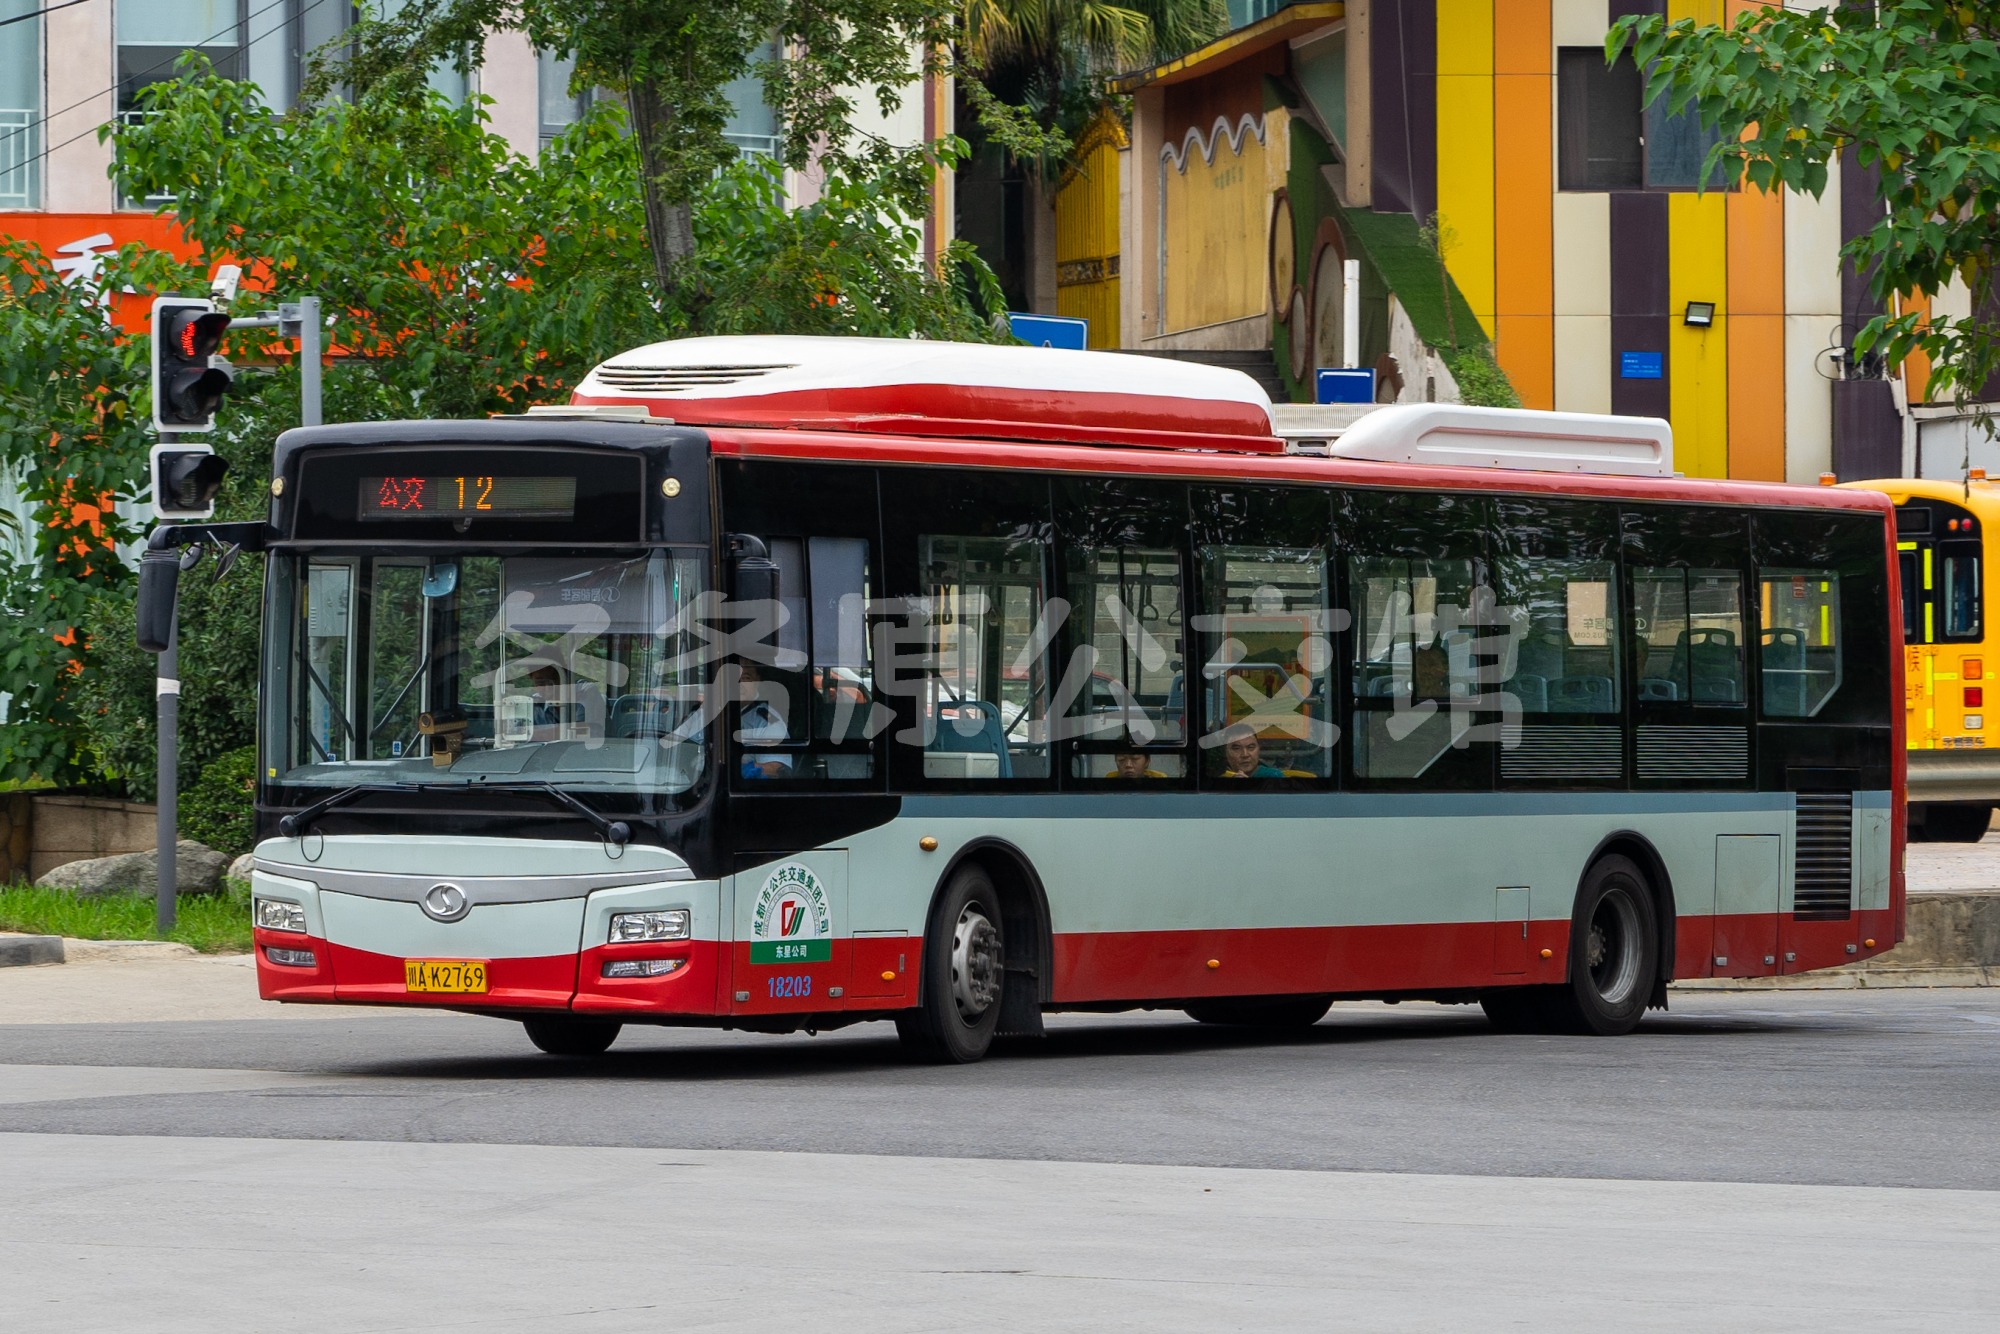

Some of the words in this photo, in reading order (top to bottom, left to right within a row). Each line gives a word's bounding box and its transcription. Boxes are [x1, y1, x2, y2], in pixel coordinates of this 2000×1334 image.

[379, 477, 426, 510] 公交
[455, 476, 493, 510] 12
[753, 866, 829, 937] 成都市公共交通集团公司
[776, 944, 808, 959] 东星公司
[767, 975, 812, 998] 18203
